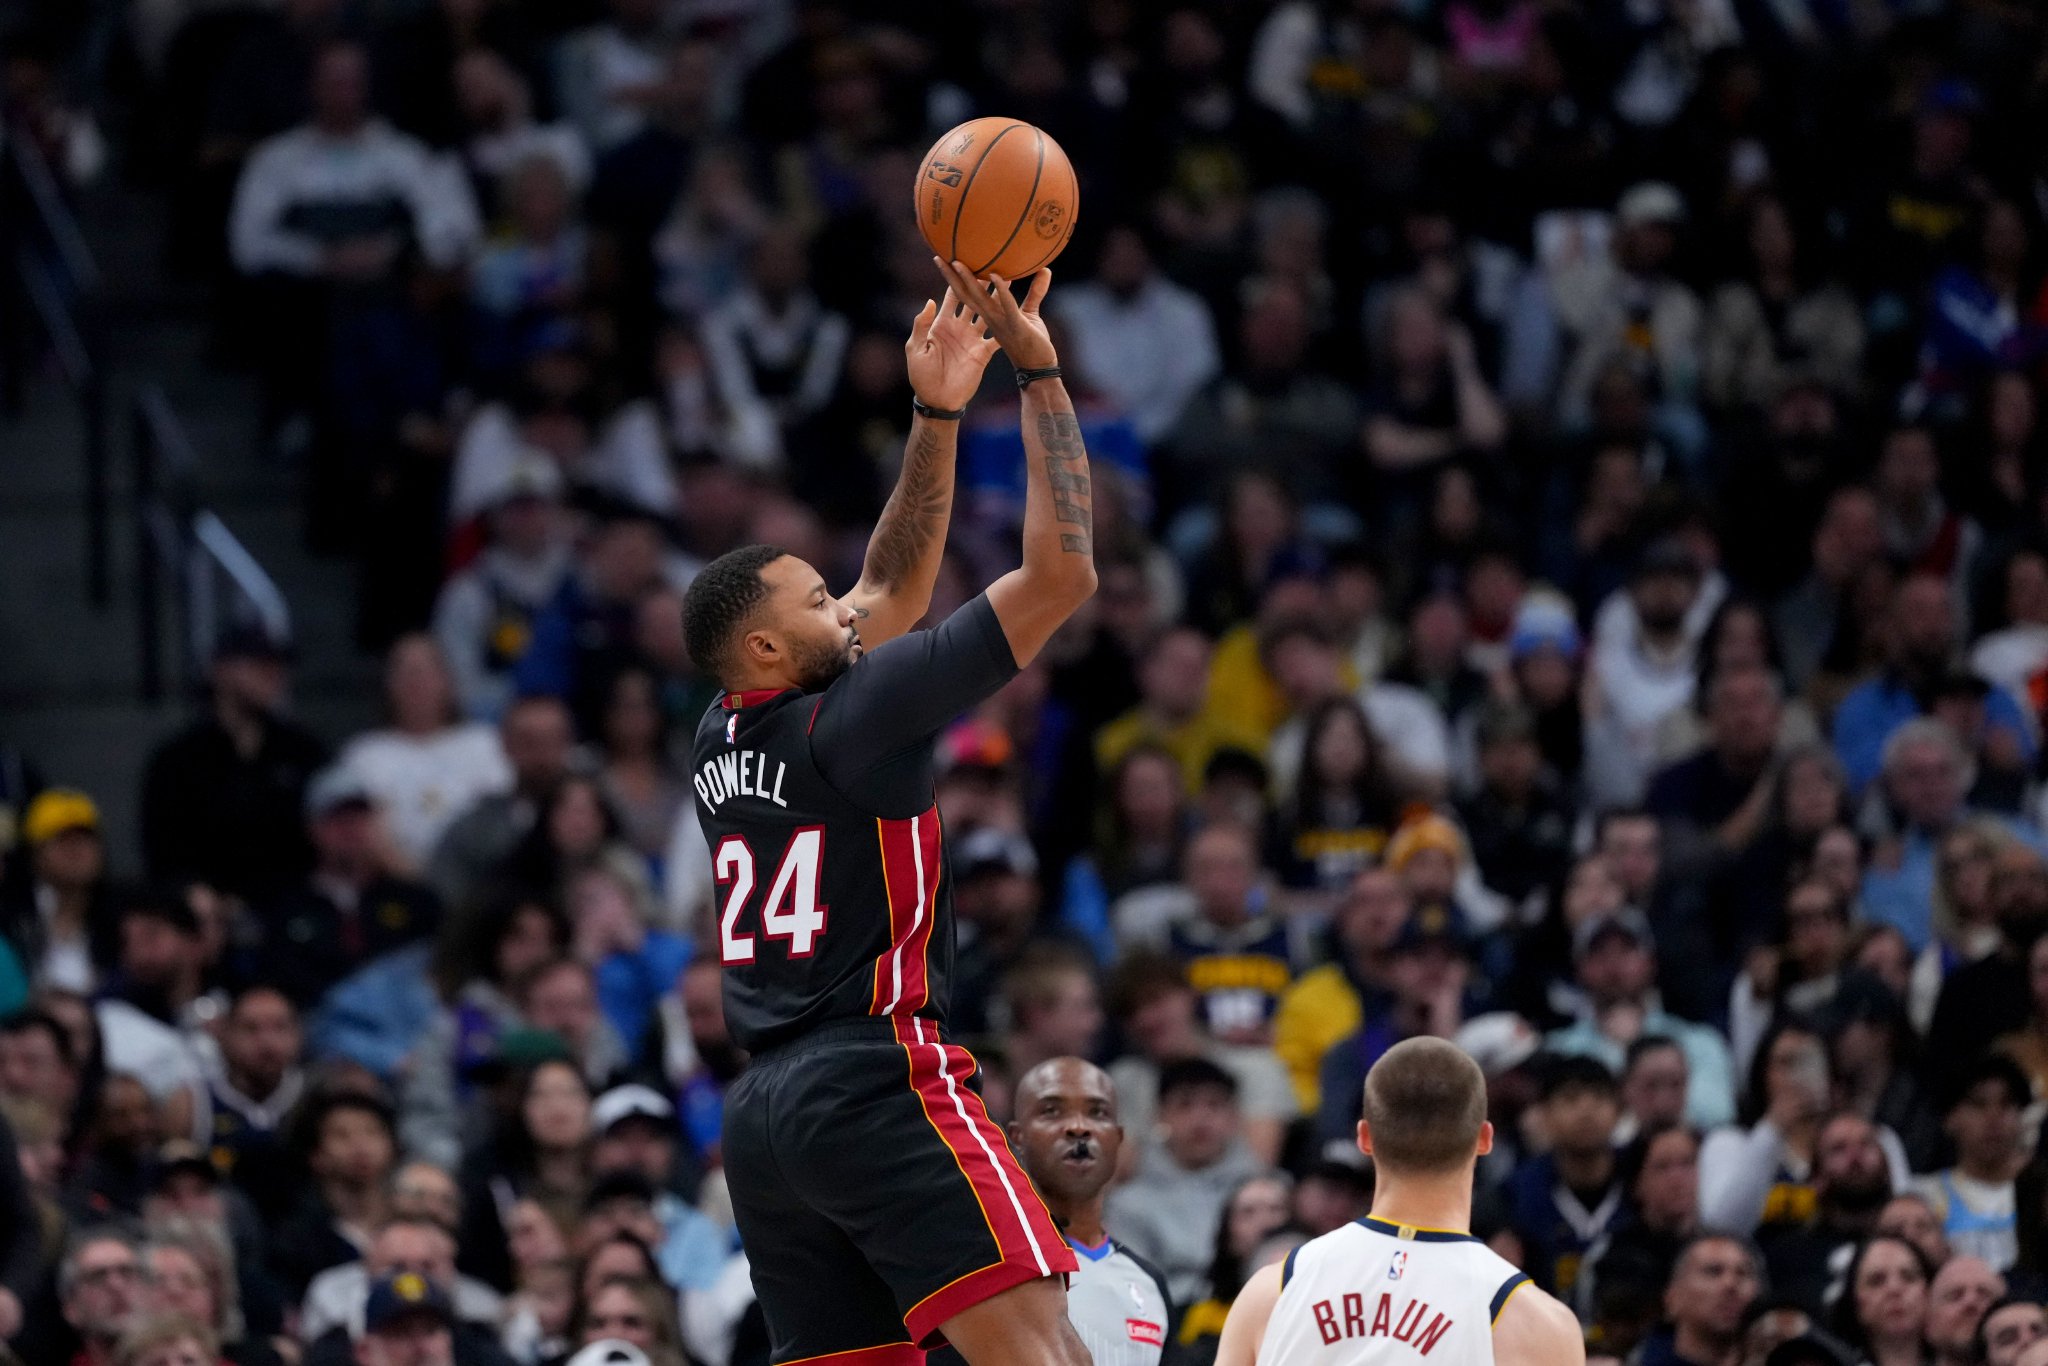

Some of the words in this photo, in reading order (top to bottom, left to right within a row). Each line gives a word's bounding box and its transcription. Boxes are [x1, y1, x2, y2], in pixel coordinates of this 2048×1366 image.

[694, 750, 787, 815] POWELL
[713, 824, 829, 967] 24
[1312, 1293, 1453, 1357] BRAUN
